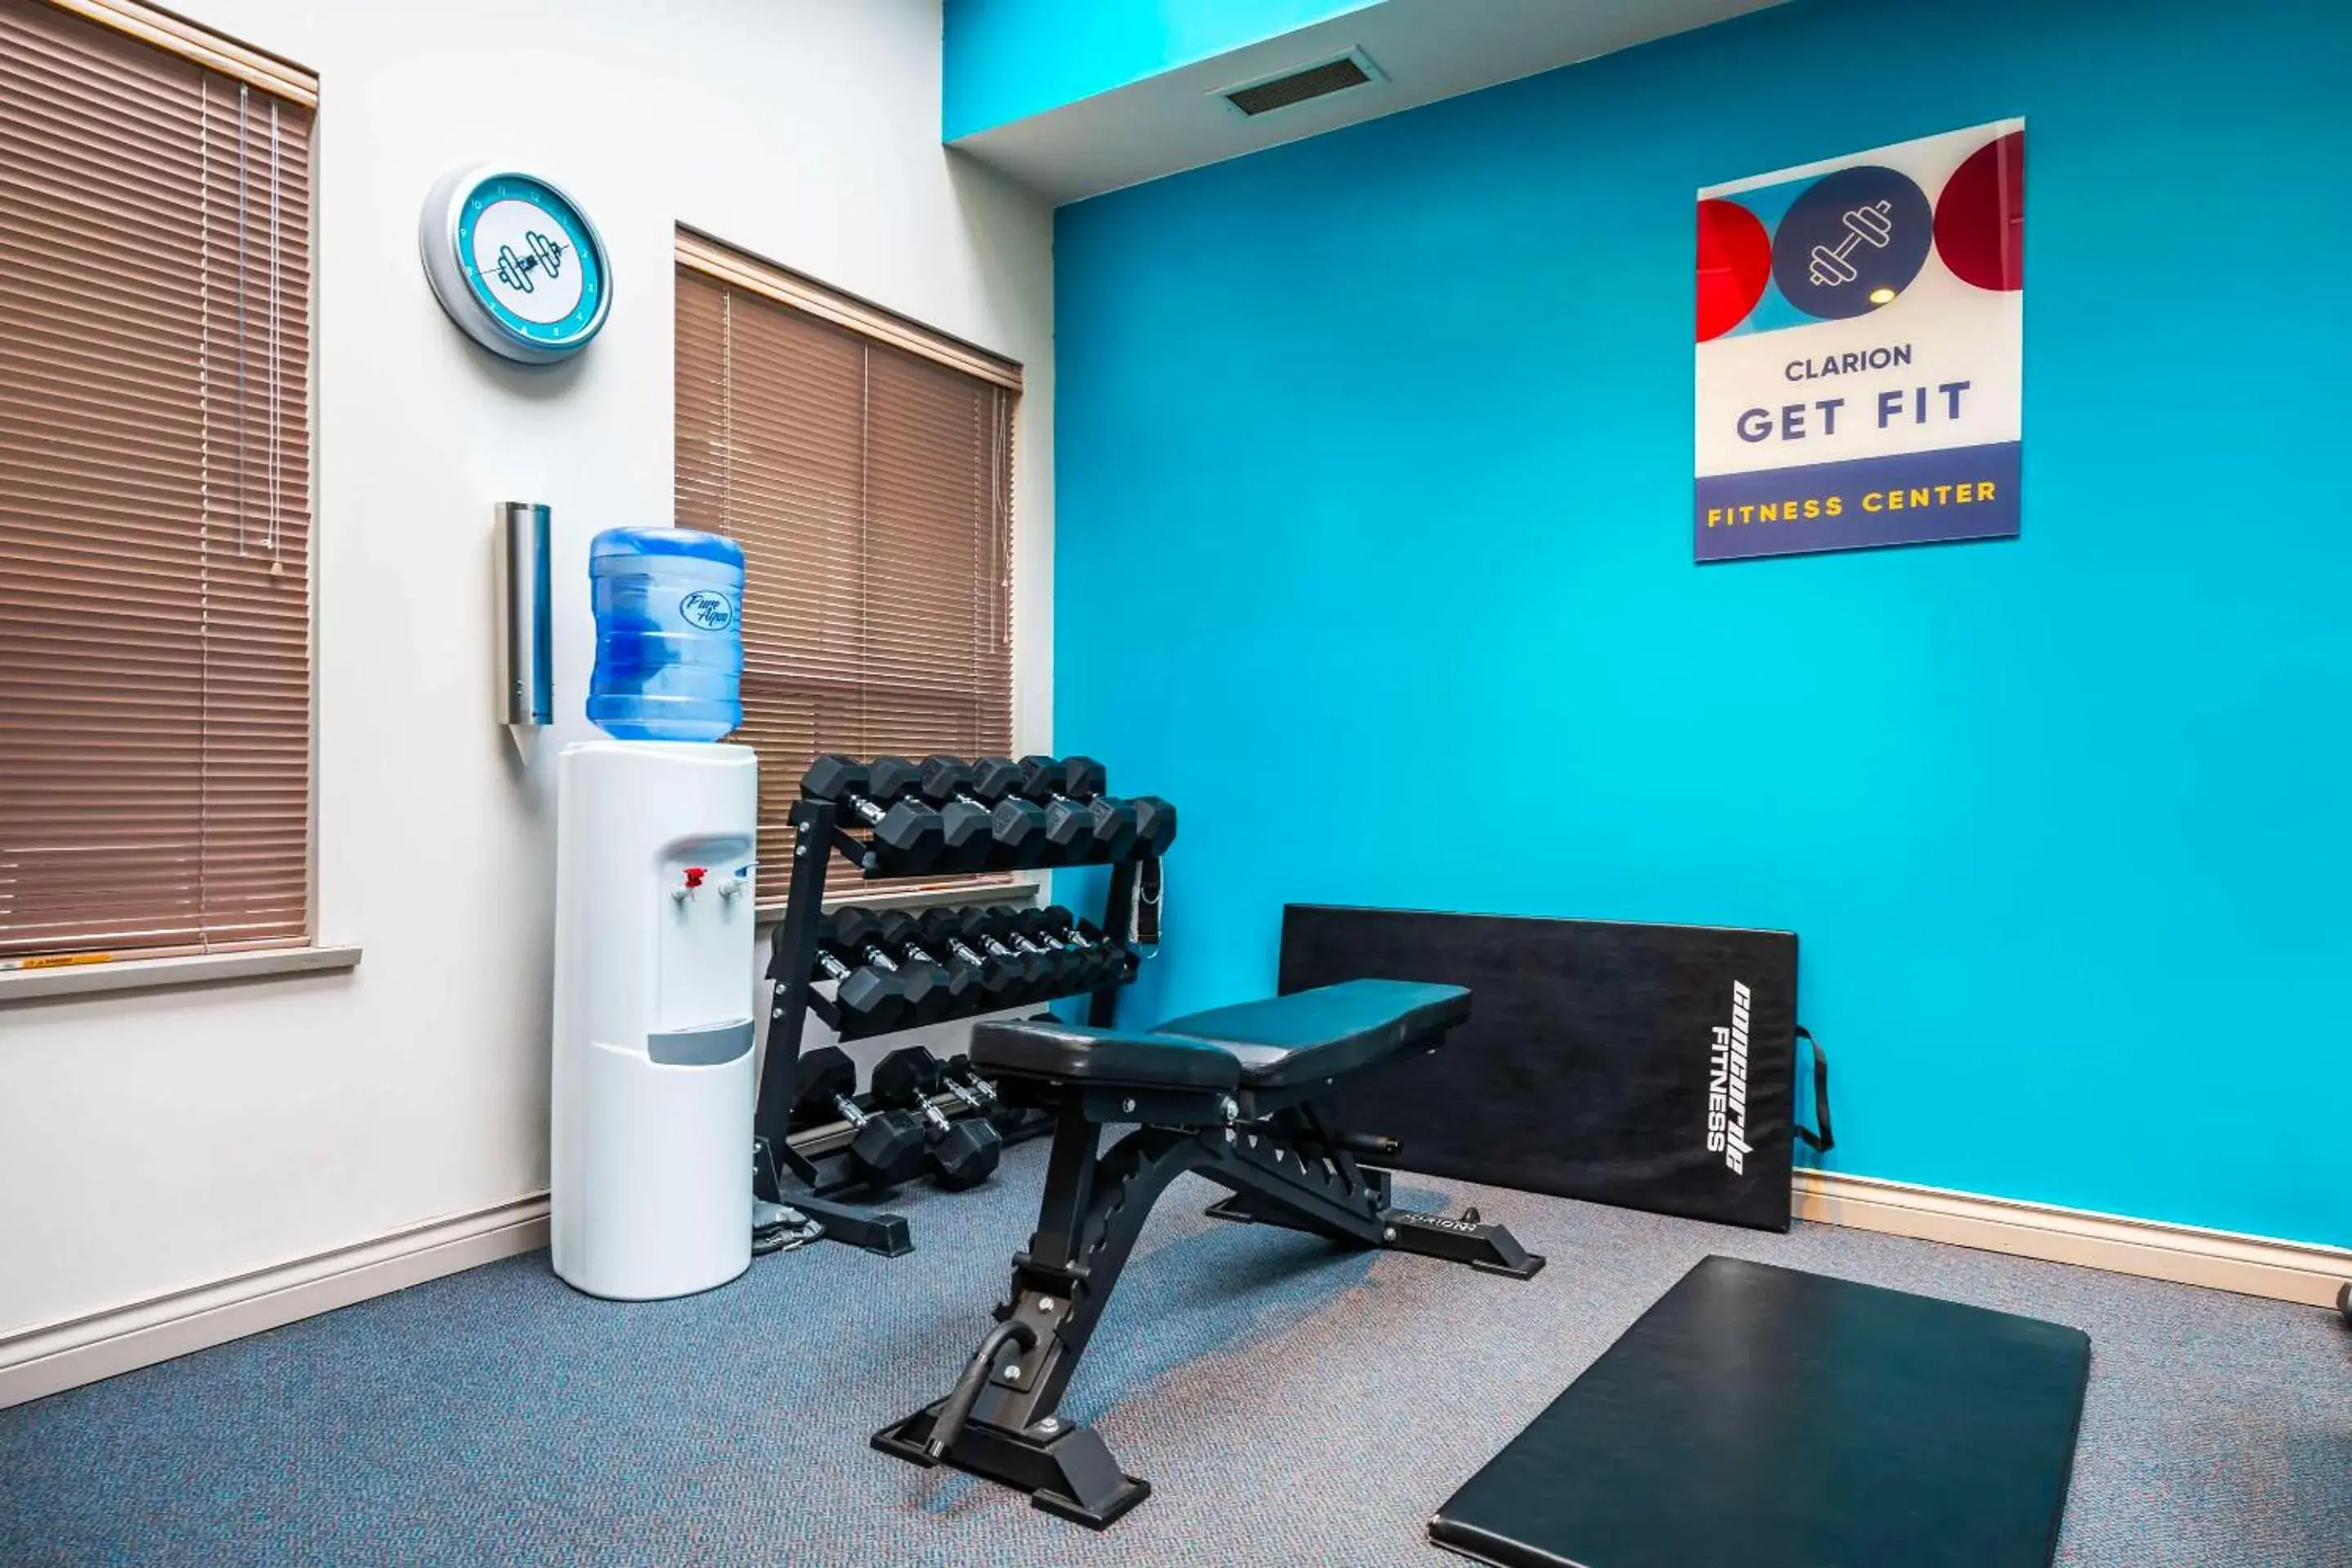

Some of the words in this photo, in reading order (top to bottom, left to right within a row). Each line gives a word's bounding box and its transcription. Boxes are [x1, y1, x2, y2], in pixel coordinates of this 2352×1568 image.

[1784, 344, 1912, 382] CLARION
[1736, 398, 1845, 443] GET
[1878, 380, 1971, 429] FIT
[1707, 495, 1843, 528] FITNESS
[1860, 480, 1997, 514] CENTER
[1707, 1026, 1731, 1153] FITNESS
